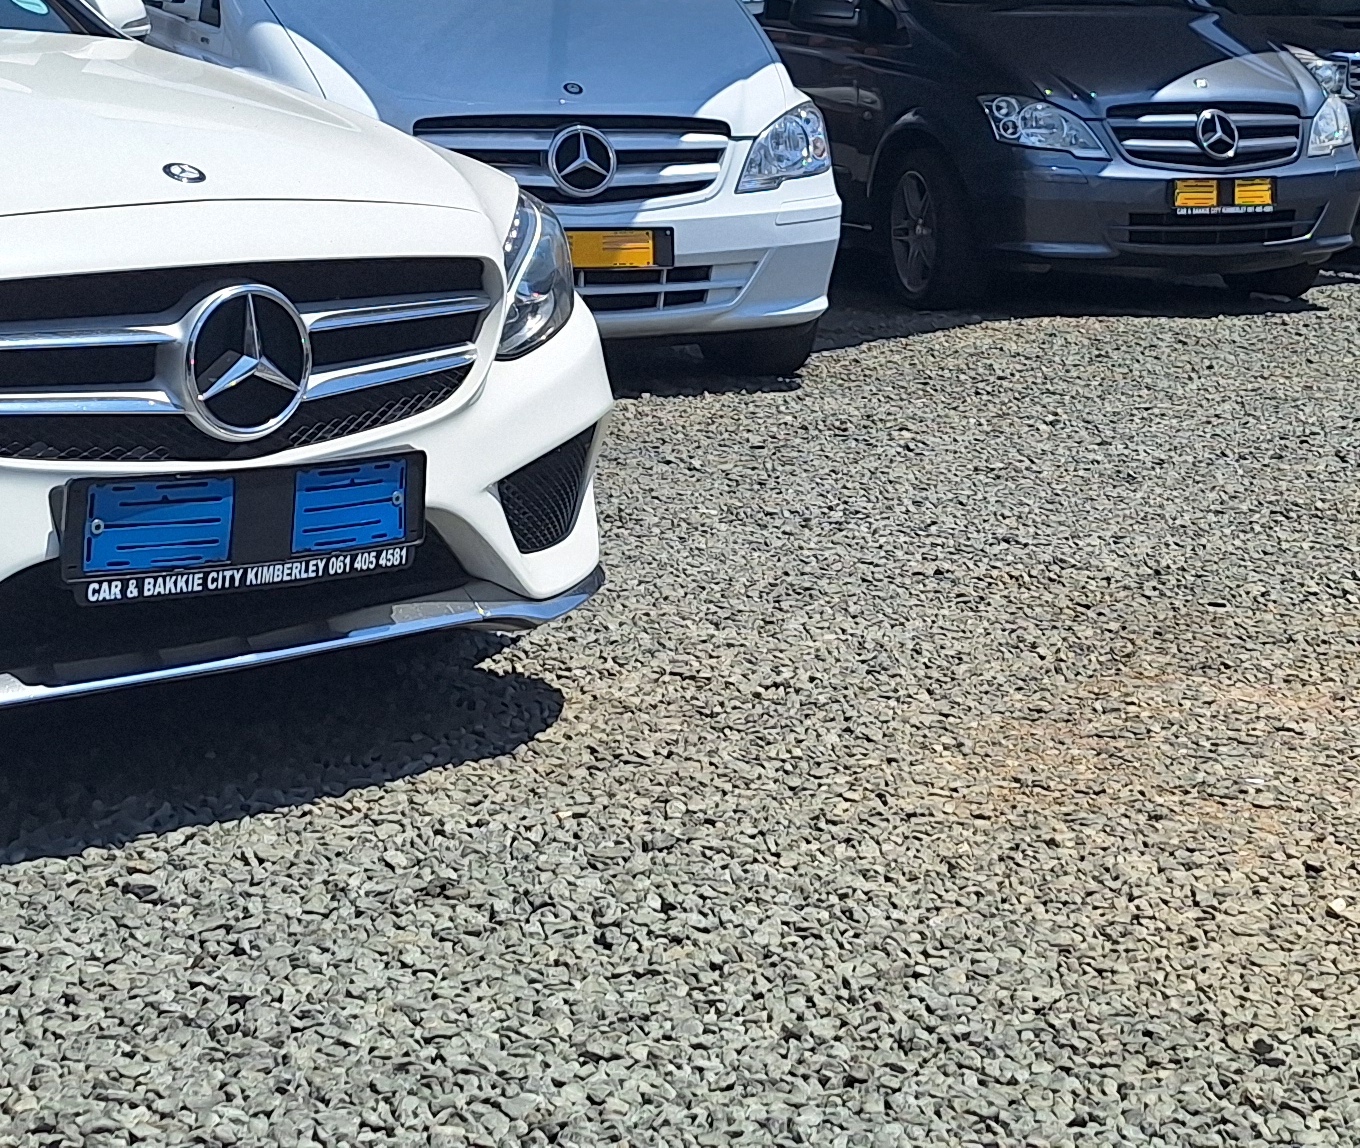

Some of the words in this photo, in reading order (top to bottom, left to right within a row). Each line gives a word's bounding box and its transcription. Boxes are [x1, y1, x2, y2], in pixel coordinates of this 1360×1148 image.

[87, 580, 122, 602] CAR
[126, 579, 139, 598] &
[143, 573, 204, 597] BAKKIE
[207, 568, 243, 590] CITY
[245, 558, 327, 586] KIMBERLEY
[328, 555, 351, 575] 061
[353, 551, 377, 571] 405
[378, 547, 407, 568] 4581
